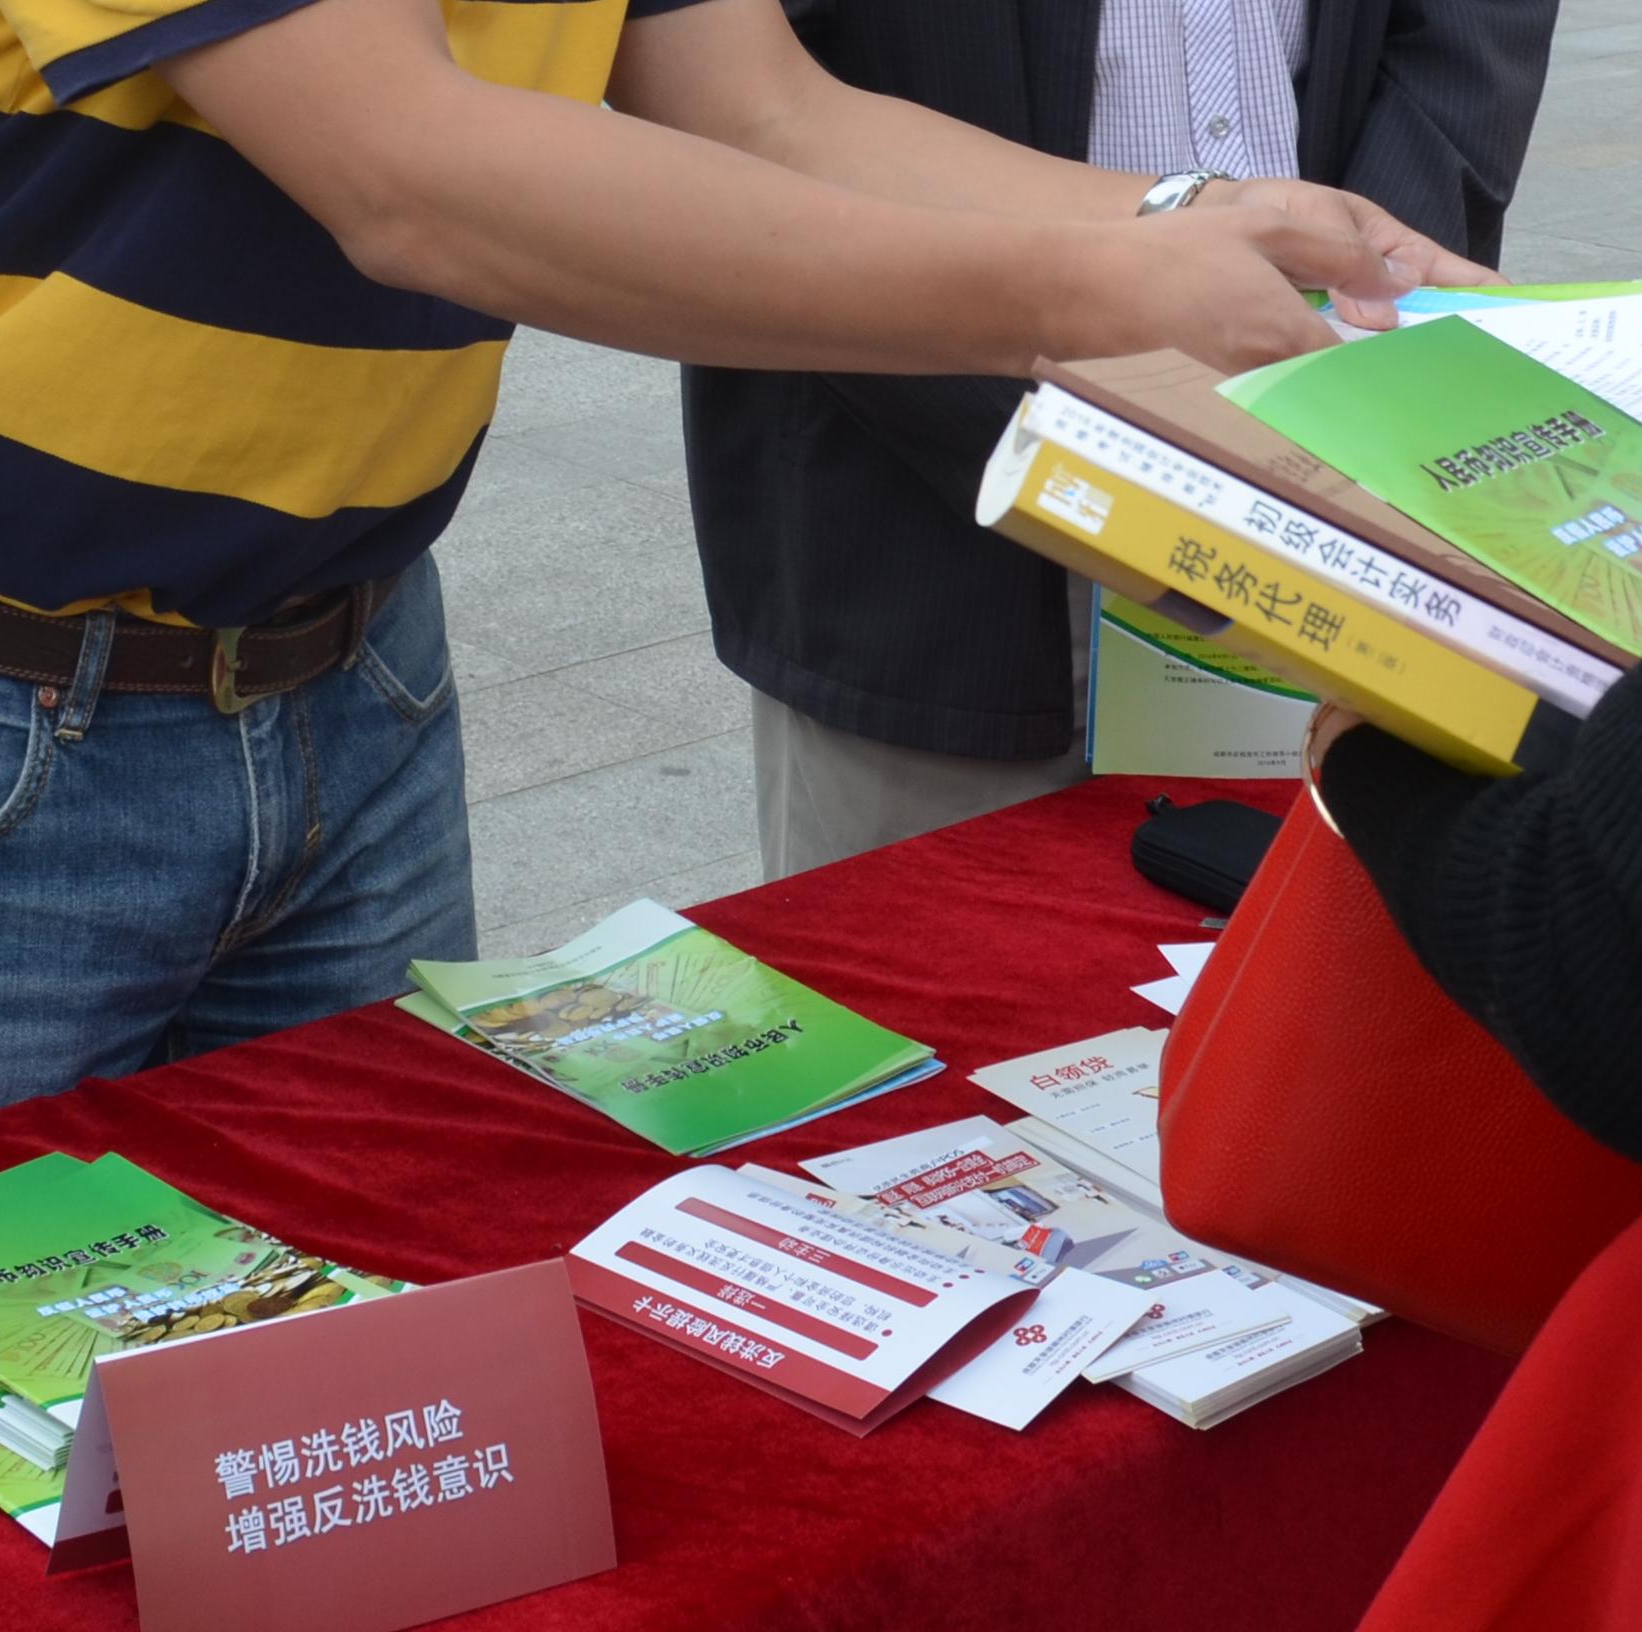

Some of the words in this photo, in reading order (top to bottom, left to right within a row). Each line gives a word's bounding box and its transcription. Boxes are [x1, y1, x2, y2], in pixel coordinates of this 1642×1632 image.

[1167, 534, 1349, 652] 税务代理
[1243, 499, 1462, 628] 初级会计实务
[715, 1282, 766, 1311] 一选择
[777, 1236, 832, 1264] 三主动
[631, 1294, 787, 1370] 反洗钱风险提示卡
[214, 1399, 464, 1500] 警惕洗钱风险
[224, 1443, 516, 1555] 增强反洗钱意识
